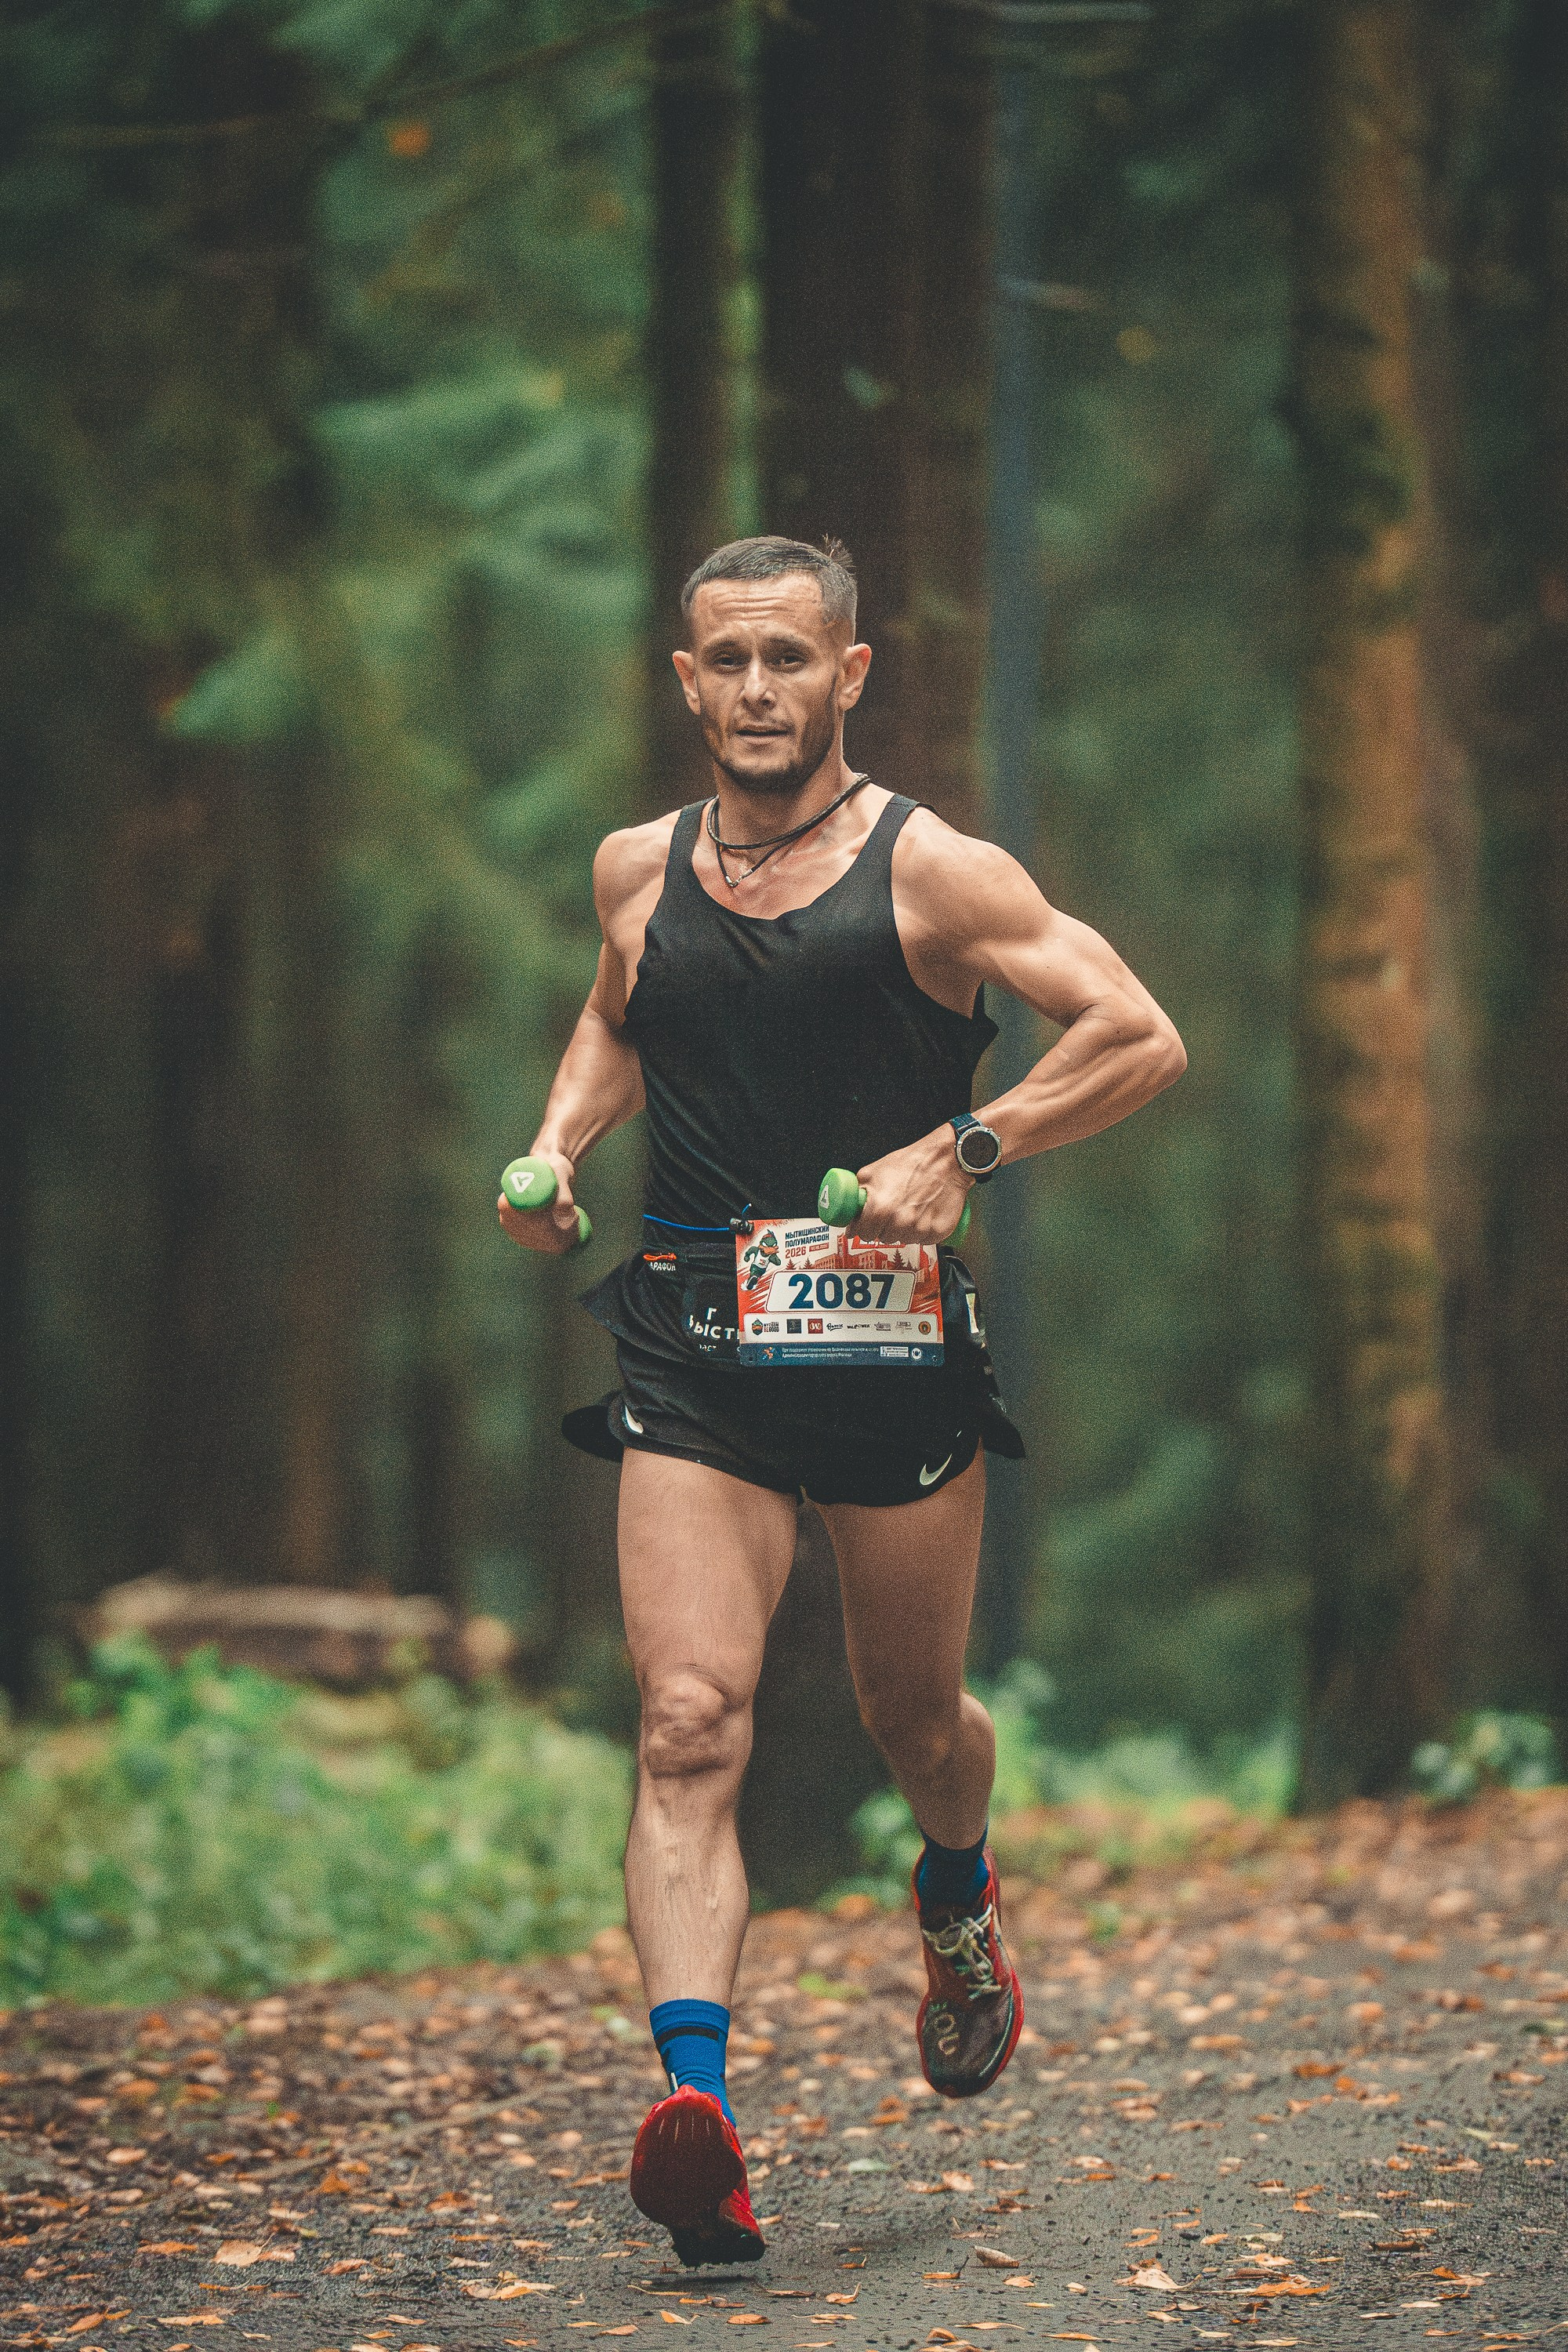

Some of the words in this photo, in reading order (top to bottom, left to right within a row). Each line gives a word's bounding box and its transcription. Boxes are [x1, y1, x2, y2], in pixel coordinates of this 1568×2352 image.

[785, 1232, 829, 1248] ПОЛУМАРАФОН
[785, 1246, 807, 1259] 2026
[788, 1272, 895, 1309] 2087
